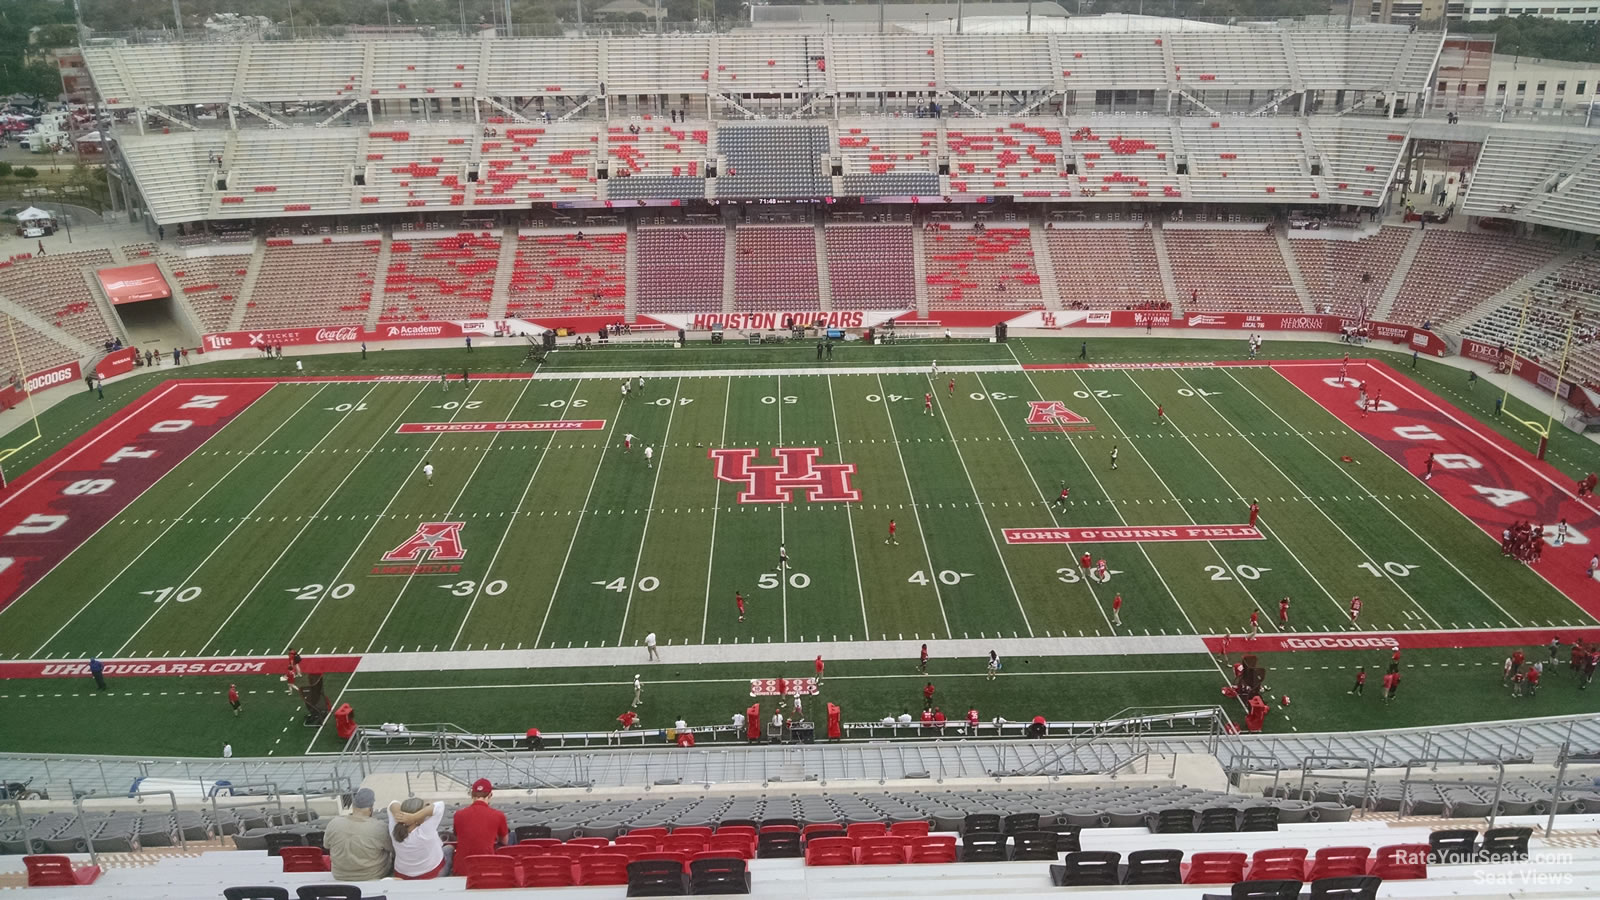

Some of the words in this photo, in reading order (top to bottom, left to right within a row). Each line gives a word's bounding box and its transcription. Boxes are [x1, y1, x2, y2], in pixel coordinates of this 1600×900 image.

[693, 313, 776, 329] HOUSTON
[780, 311, 863, 328] COUGARS
[316, 326, 358, 342] Coca-Cola
[400, 325, 442, 334] Academy
[1377, 326, 1408, 335] STUDENT
[207, 335, 232, 349] Lite
[495, 421, 584, 430] STADIUM
[708, 447, 862, 504] UH
[1008, 531, 1070, 541] JOHN
[1081, 528, 1180, 539] O'QUINN
[1189, 526, 1258, 537] FIELD
[1056, 567, 1112, 584] 30
[1204, 564, 1262, 581] 20
[1357, 561, 1410, 578] 10
[605, 576, 660, 592] 40
[757, 573, 811, 590] 50
[908, 570, 962, 586] 40
[153, 586, 203, 603] 10
[294, 583, 356, 600] 20
[451, 580, 508, 596] 30
